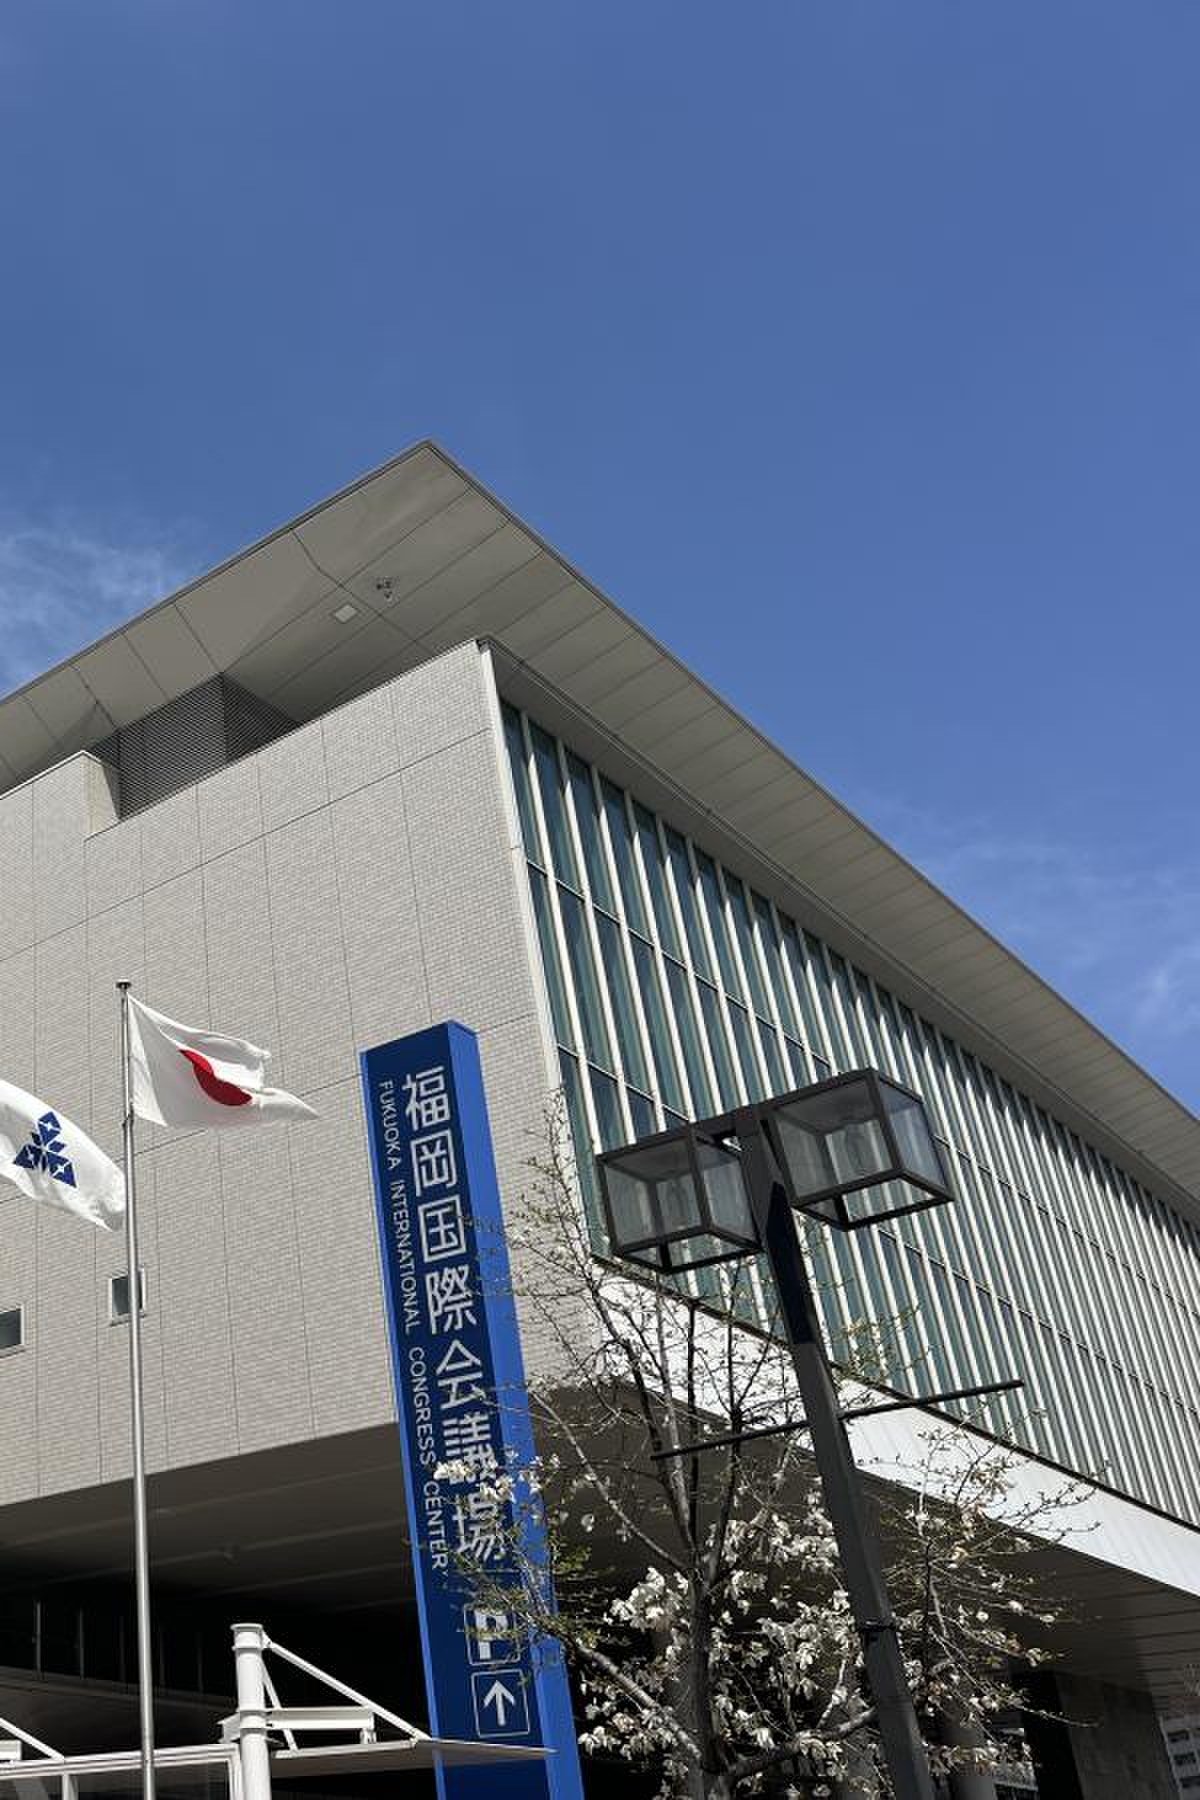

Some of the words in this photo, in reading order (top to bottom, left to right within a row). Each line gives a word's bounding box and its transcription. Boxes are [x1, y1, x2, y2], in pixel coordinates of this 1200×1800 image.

[378, 1080, 401, 1171] FUKUOKA
[389, 1180, 420, 1336] INTERNATIONAL
[401, 1065, 503, 1562] 福岡国際会議場
[408, 1346, 437, 1466] CONGRESS
[423, 1480, 449, 1569] CENTER
